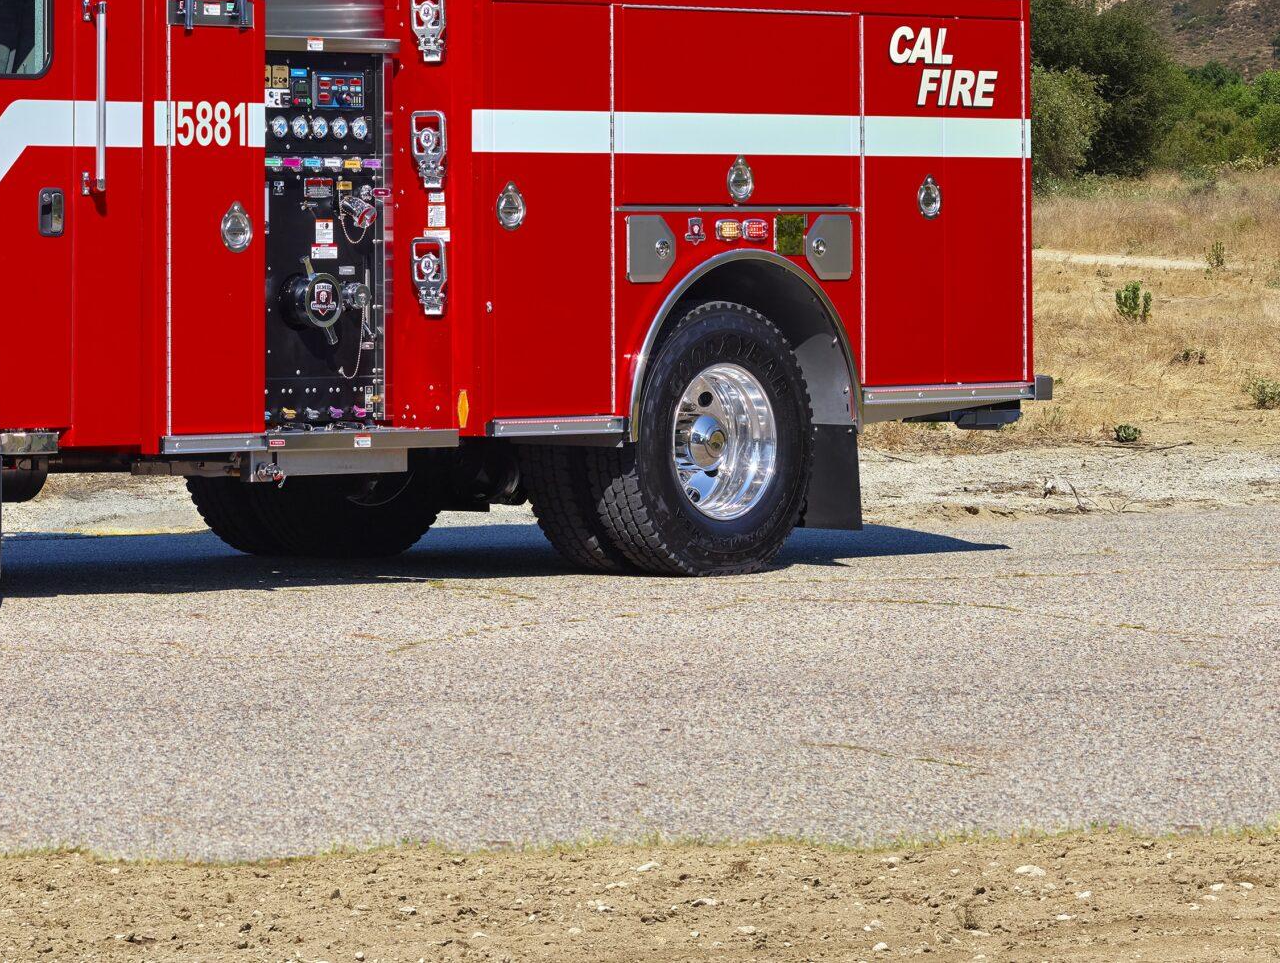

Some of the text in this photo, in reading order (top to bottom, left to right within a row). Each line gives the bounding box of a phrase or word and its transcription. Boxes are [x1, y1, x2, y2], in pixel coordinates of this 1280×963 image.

[889, 25, 954, 65] CAL
[917, 68, 999, 107] FIRE
[177, 100, 246, 147] 5881
